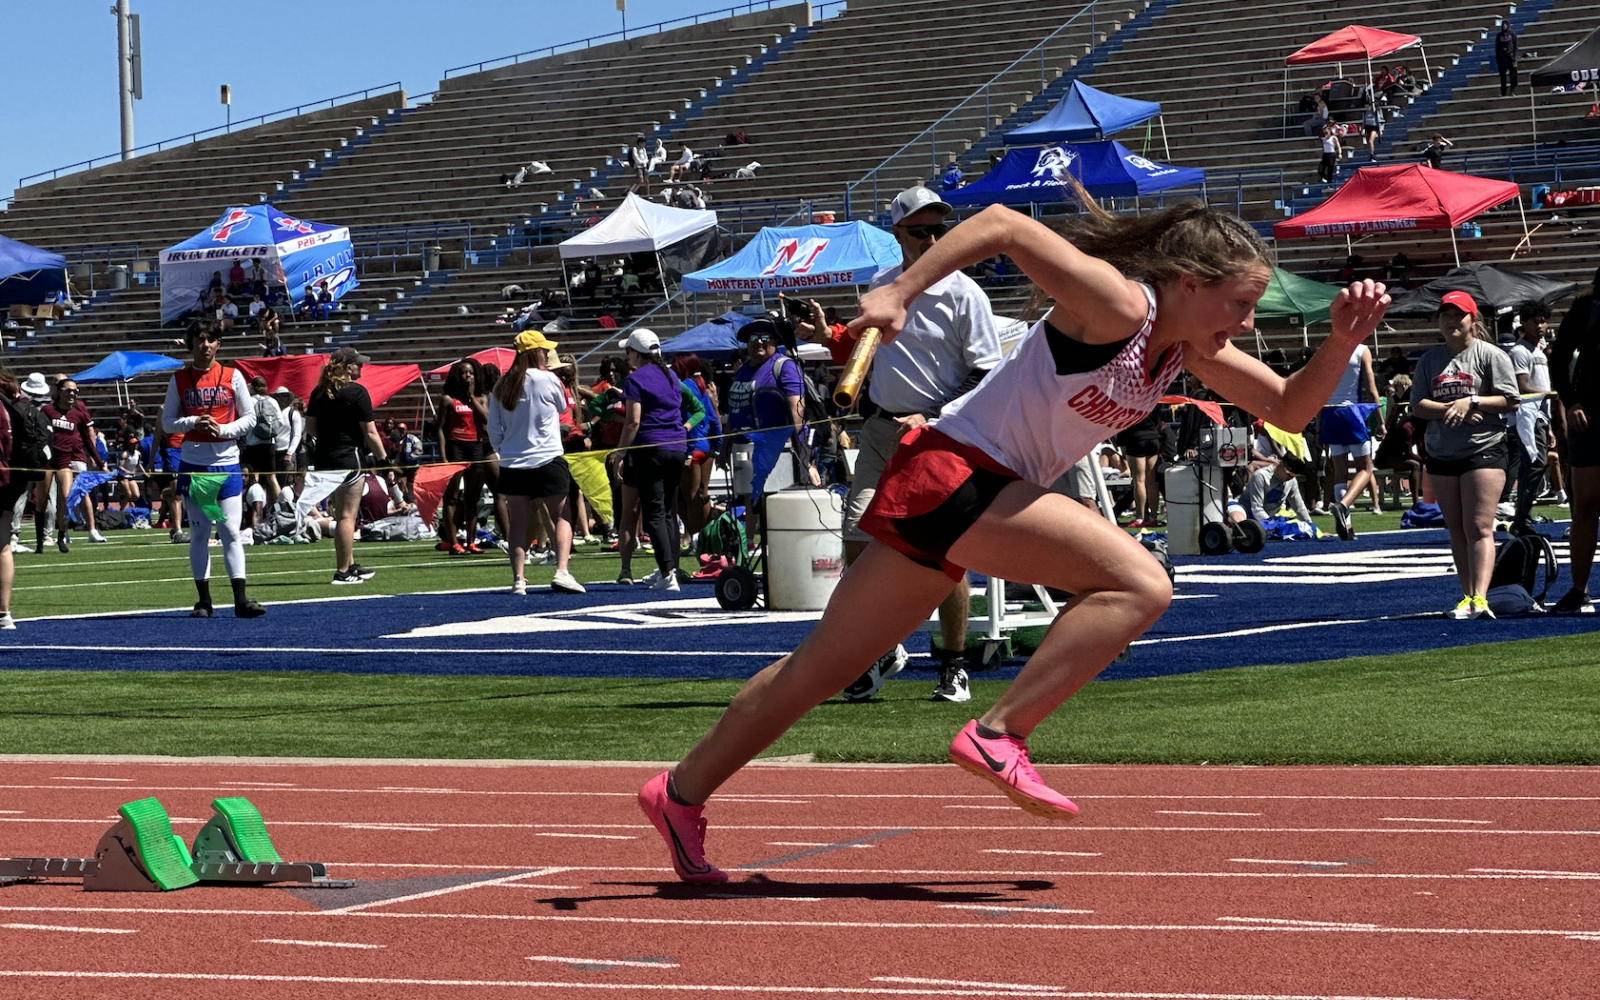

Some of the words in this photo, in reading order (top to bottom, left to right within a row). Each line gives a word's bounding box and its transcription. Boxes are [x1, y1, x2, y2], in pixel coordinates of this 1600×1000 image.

[1031, 179, 1041, 187] &
[1304, 221, 1356, 235] MONTEREY
[1358, 218, 1417, 232] PLAINSMEN
[297, 236, 316, 249] P2B
[167, 249, 202, 263] IRVIN
[205, 246, 269, 260] ROCKETS
[760, 237, 830, 277] M
[706, 278, 765, 290] MONTEREY
[768, 273, 831, 289] PLAINSMEN
[184, 387, 229, 407] BOBCATS
[52, 419, 75, 431] REBELS
